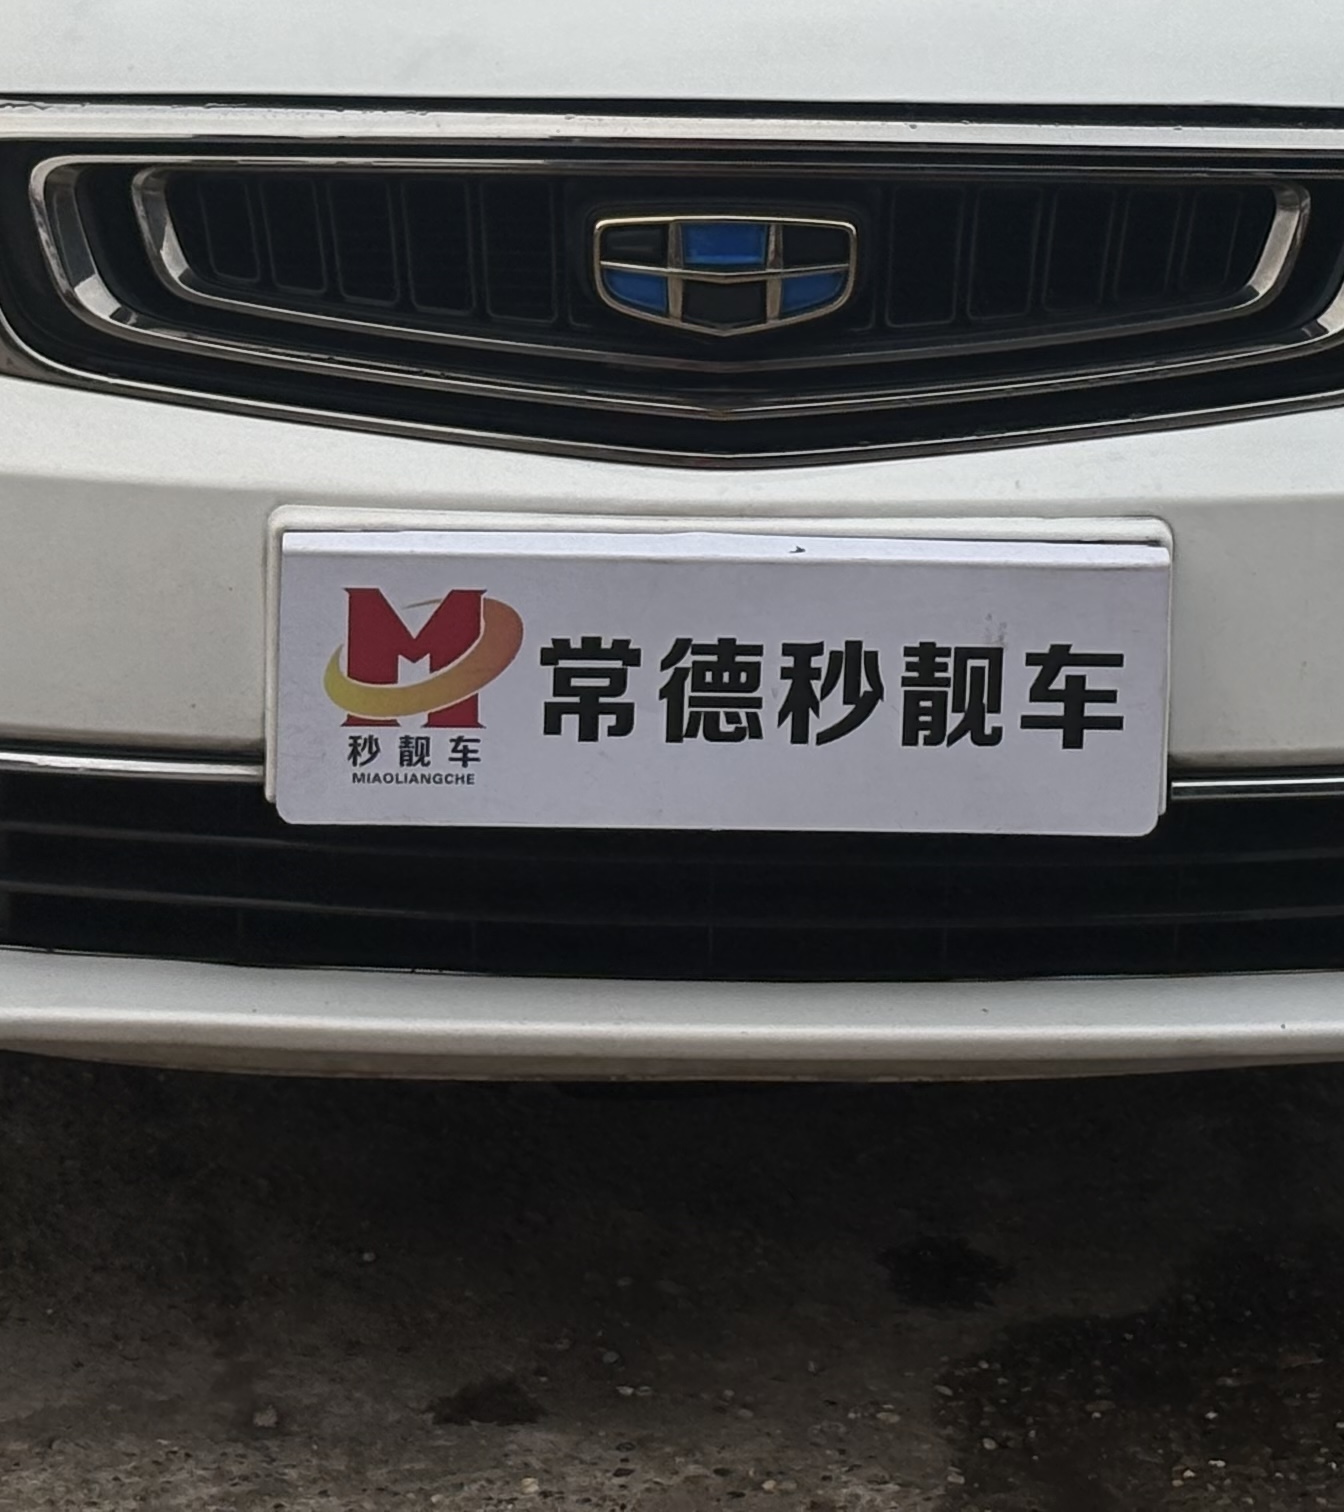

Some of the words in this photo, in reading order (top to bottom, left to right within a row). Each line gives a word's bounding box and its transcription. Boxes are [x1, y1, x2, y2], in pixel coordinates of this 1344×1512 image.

[539, 636, 1125, 750] 常德秒靓车
[347, 734, 482, 768] 秒靓车
[351, 772, 476, 786] MIAOLIANGCHE
